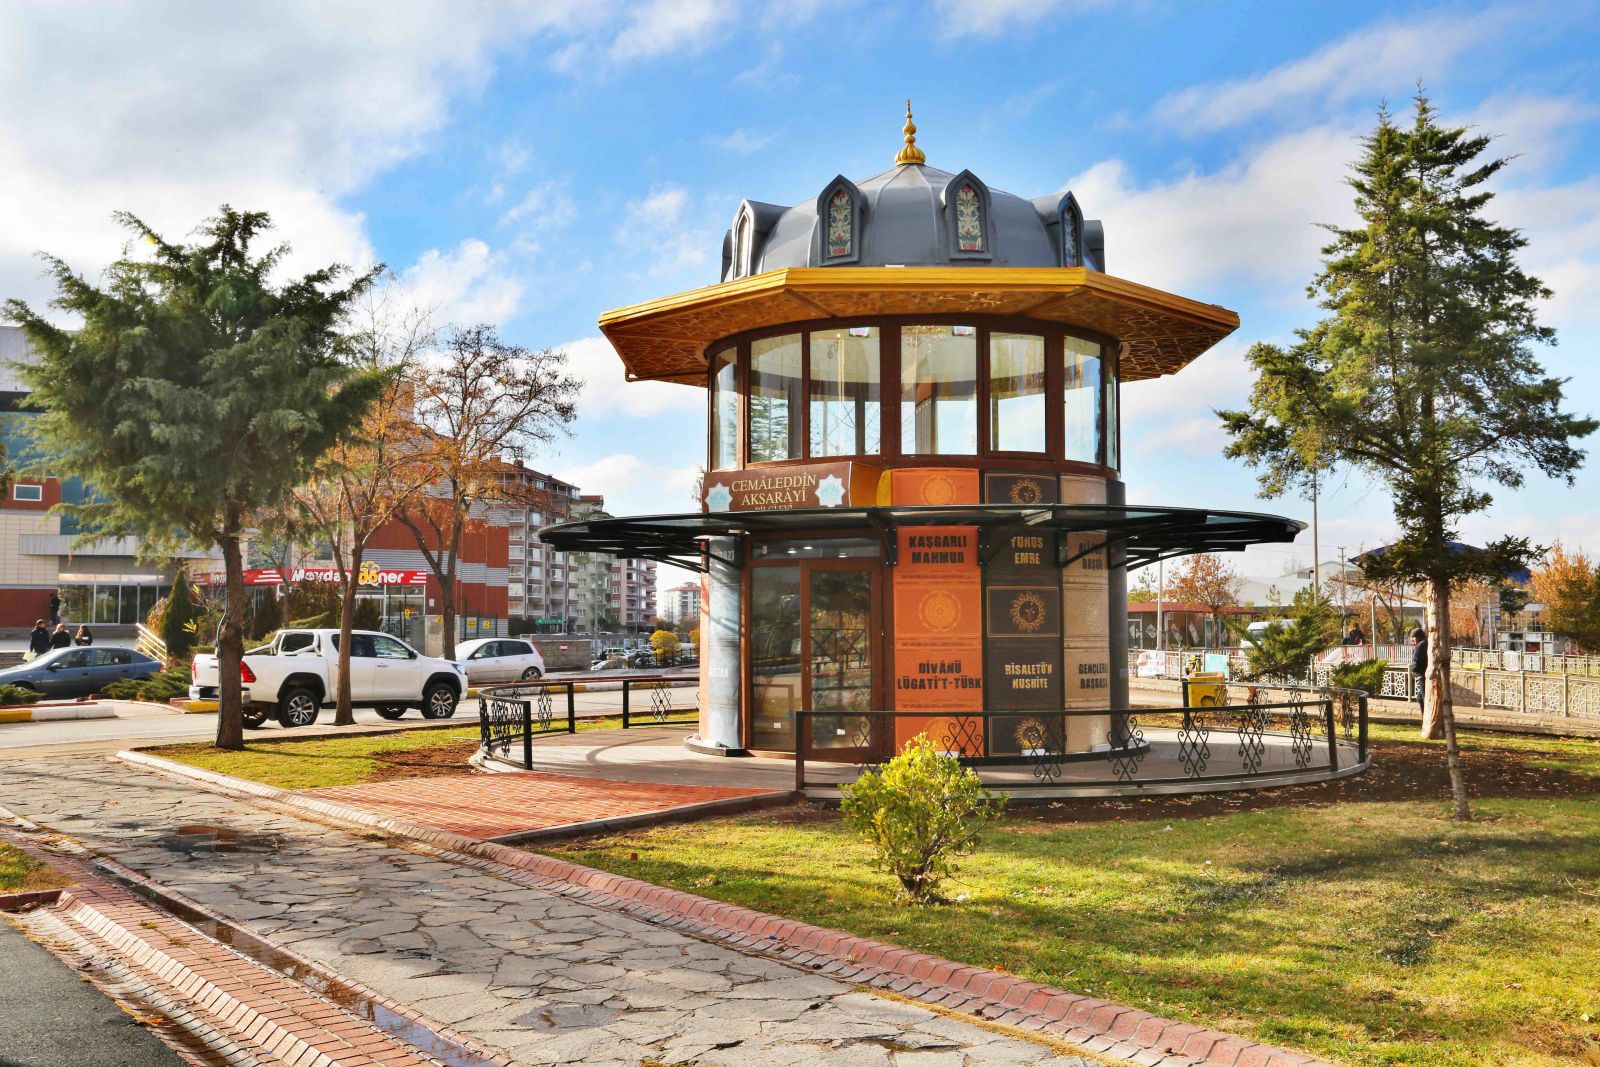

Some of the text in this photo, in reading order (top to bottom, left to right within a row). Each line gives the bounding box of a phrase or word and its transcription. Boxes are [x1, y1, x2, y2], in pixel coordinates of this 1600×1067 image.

[1010, 536, 1044, 549] YUNUS
[912, 551, 964, 564] MAHMUD
[1014, 552, 1041, 565] EMRE
